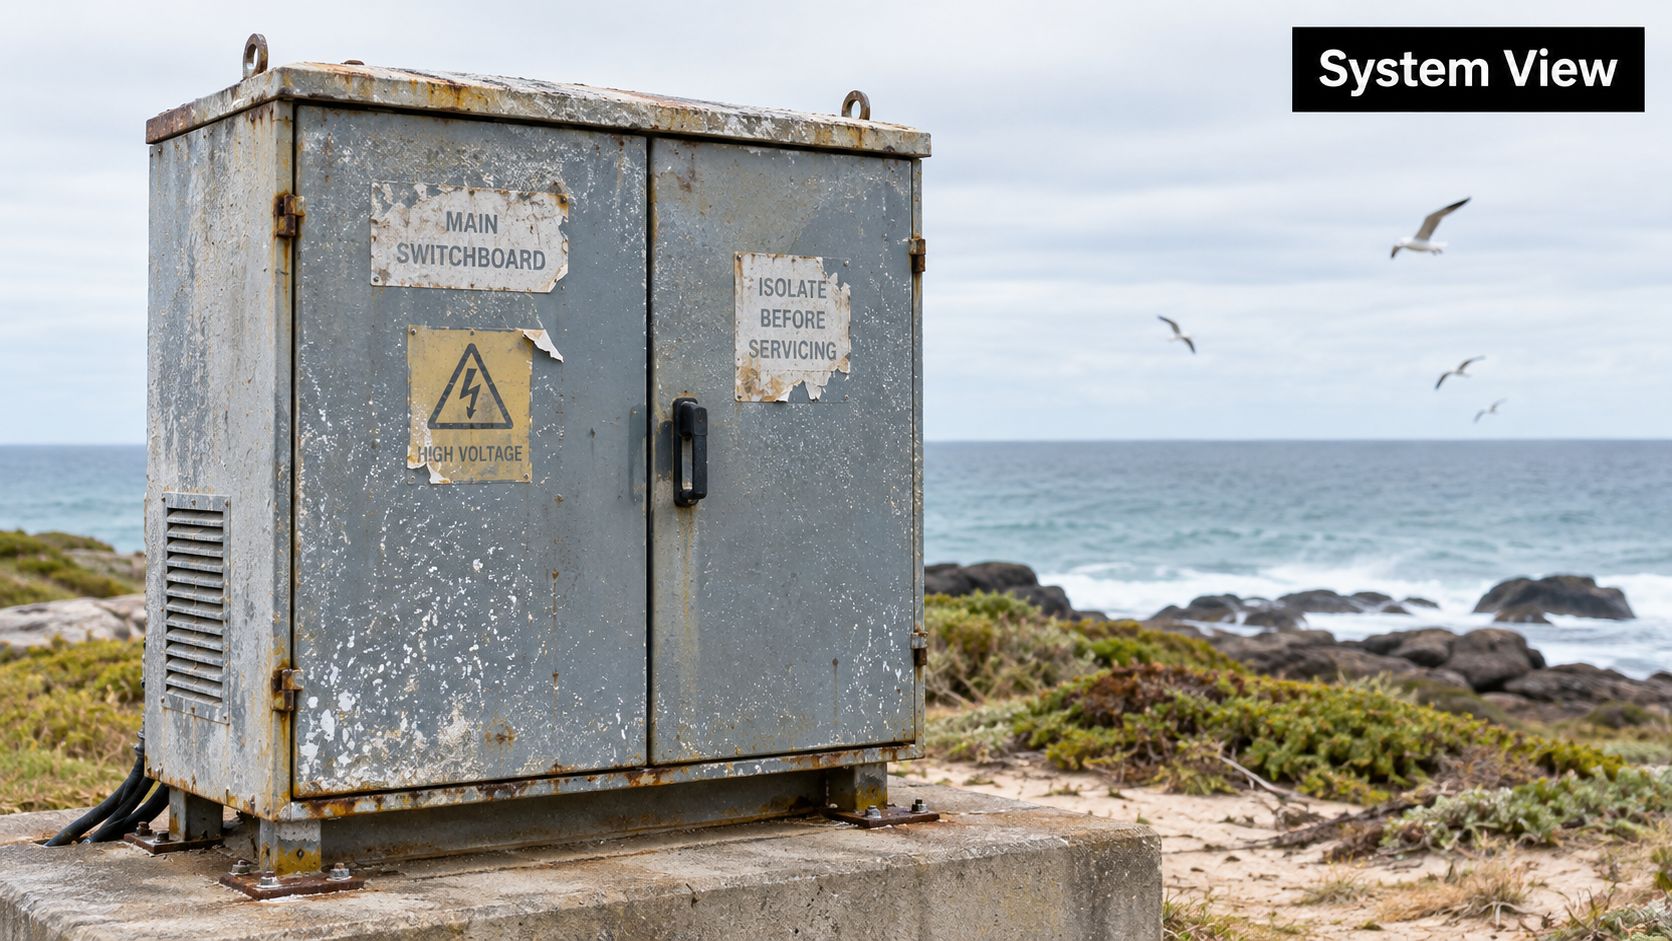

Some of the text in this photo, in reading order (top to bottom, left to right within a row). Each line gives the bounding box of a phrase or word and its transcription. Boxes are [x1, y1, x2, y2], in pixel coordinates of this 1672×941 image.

[446, 211, 498, 234] MAIN
[396, 242, 546, 270] SWITCHBOARD
[759, 277, 827, 298] ISOLATE
[760, 308, 826, 329] BEFORE
[748, 339, 837, 360] SERVICING
[458, 445, 523, 462] VOLTAGE
